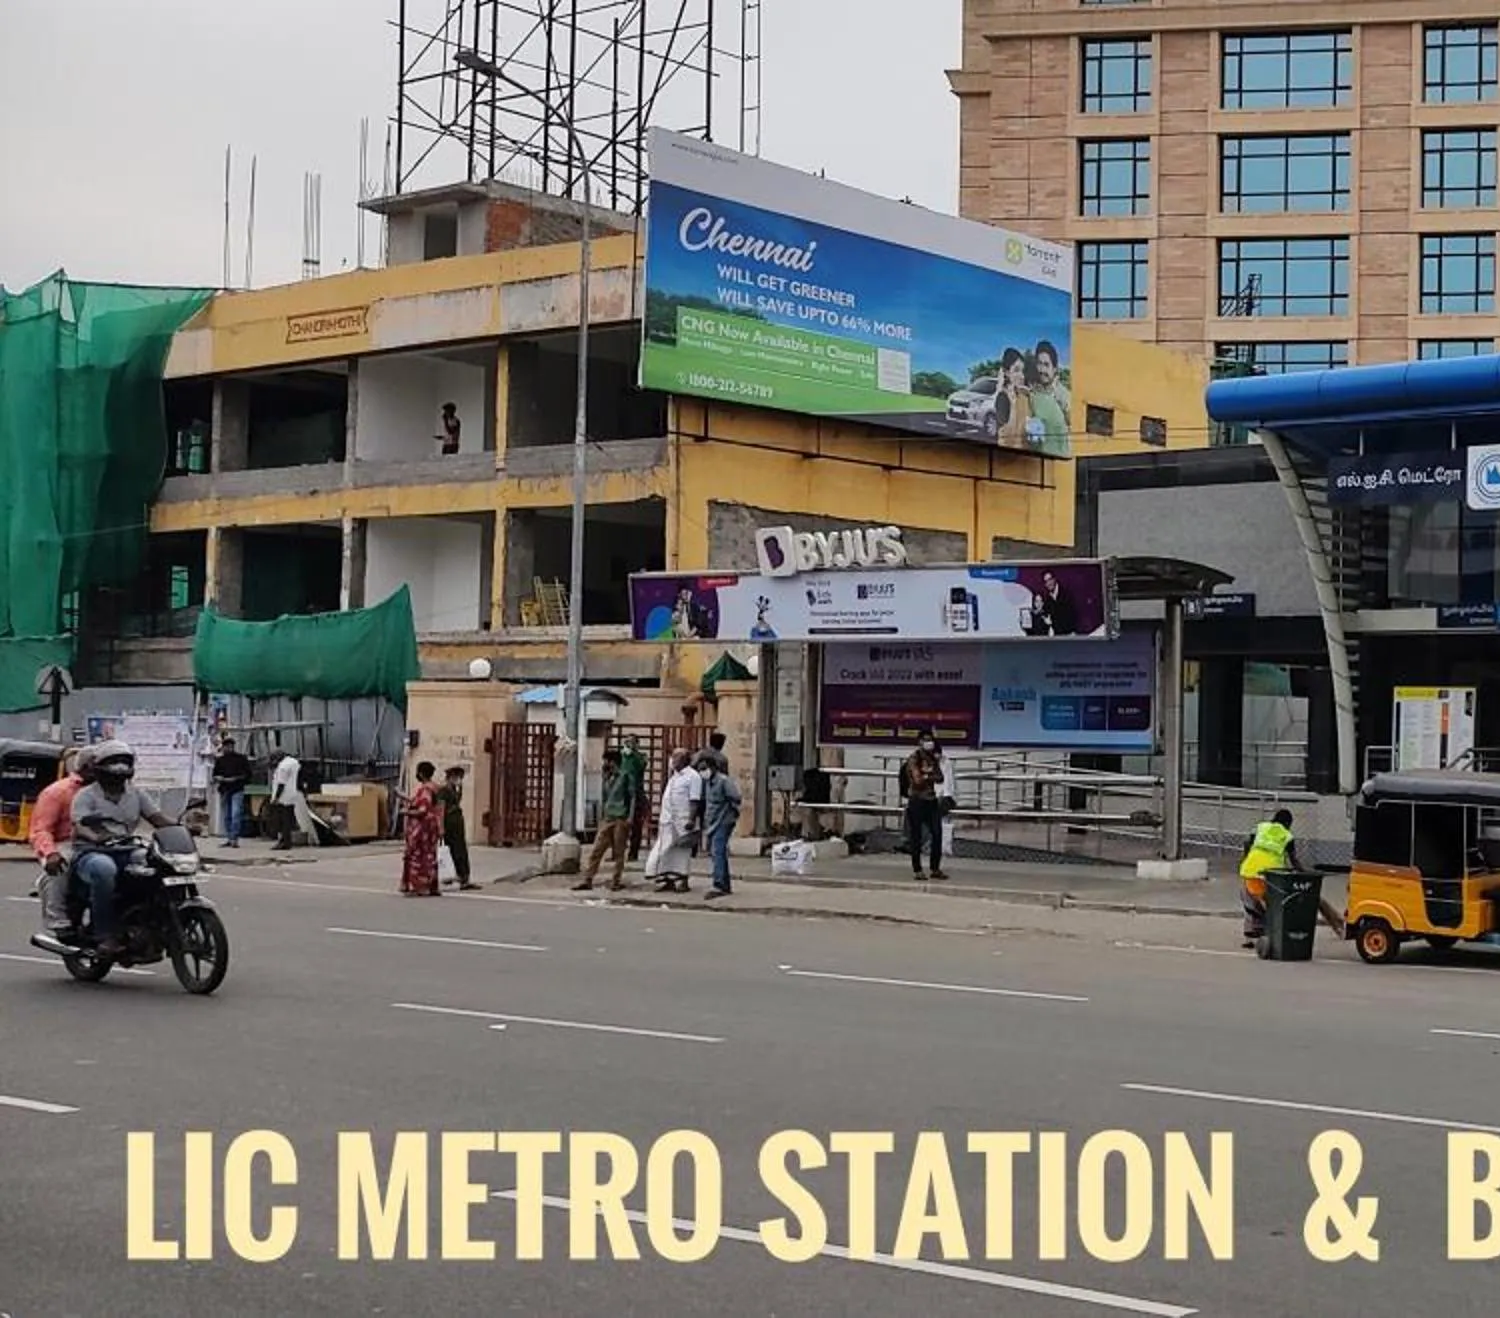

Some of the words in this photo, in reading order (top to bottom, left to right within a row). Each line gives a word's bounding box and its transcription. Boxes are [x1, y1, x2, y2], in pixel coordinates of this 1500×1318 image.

[679, 208, 817, 272] Chennai
[717, 263, 753, 285] WILL
[757, 274, 787, 292] GET
[789, 281, 855, 308] GREENER
[681, 316, 715, 334] CNG
[719, 323, 749, 340] Now
[717, 288, 752, 307] WILL
[757, 297, 795, 317] SAVE
[799, 305, 839, 325] UPTO
[873, 321, 913, 341] MORE
[794, 525, 907, 571] BYJU'S
